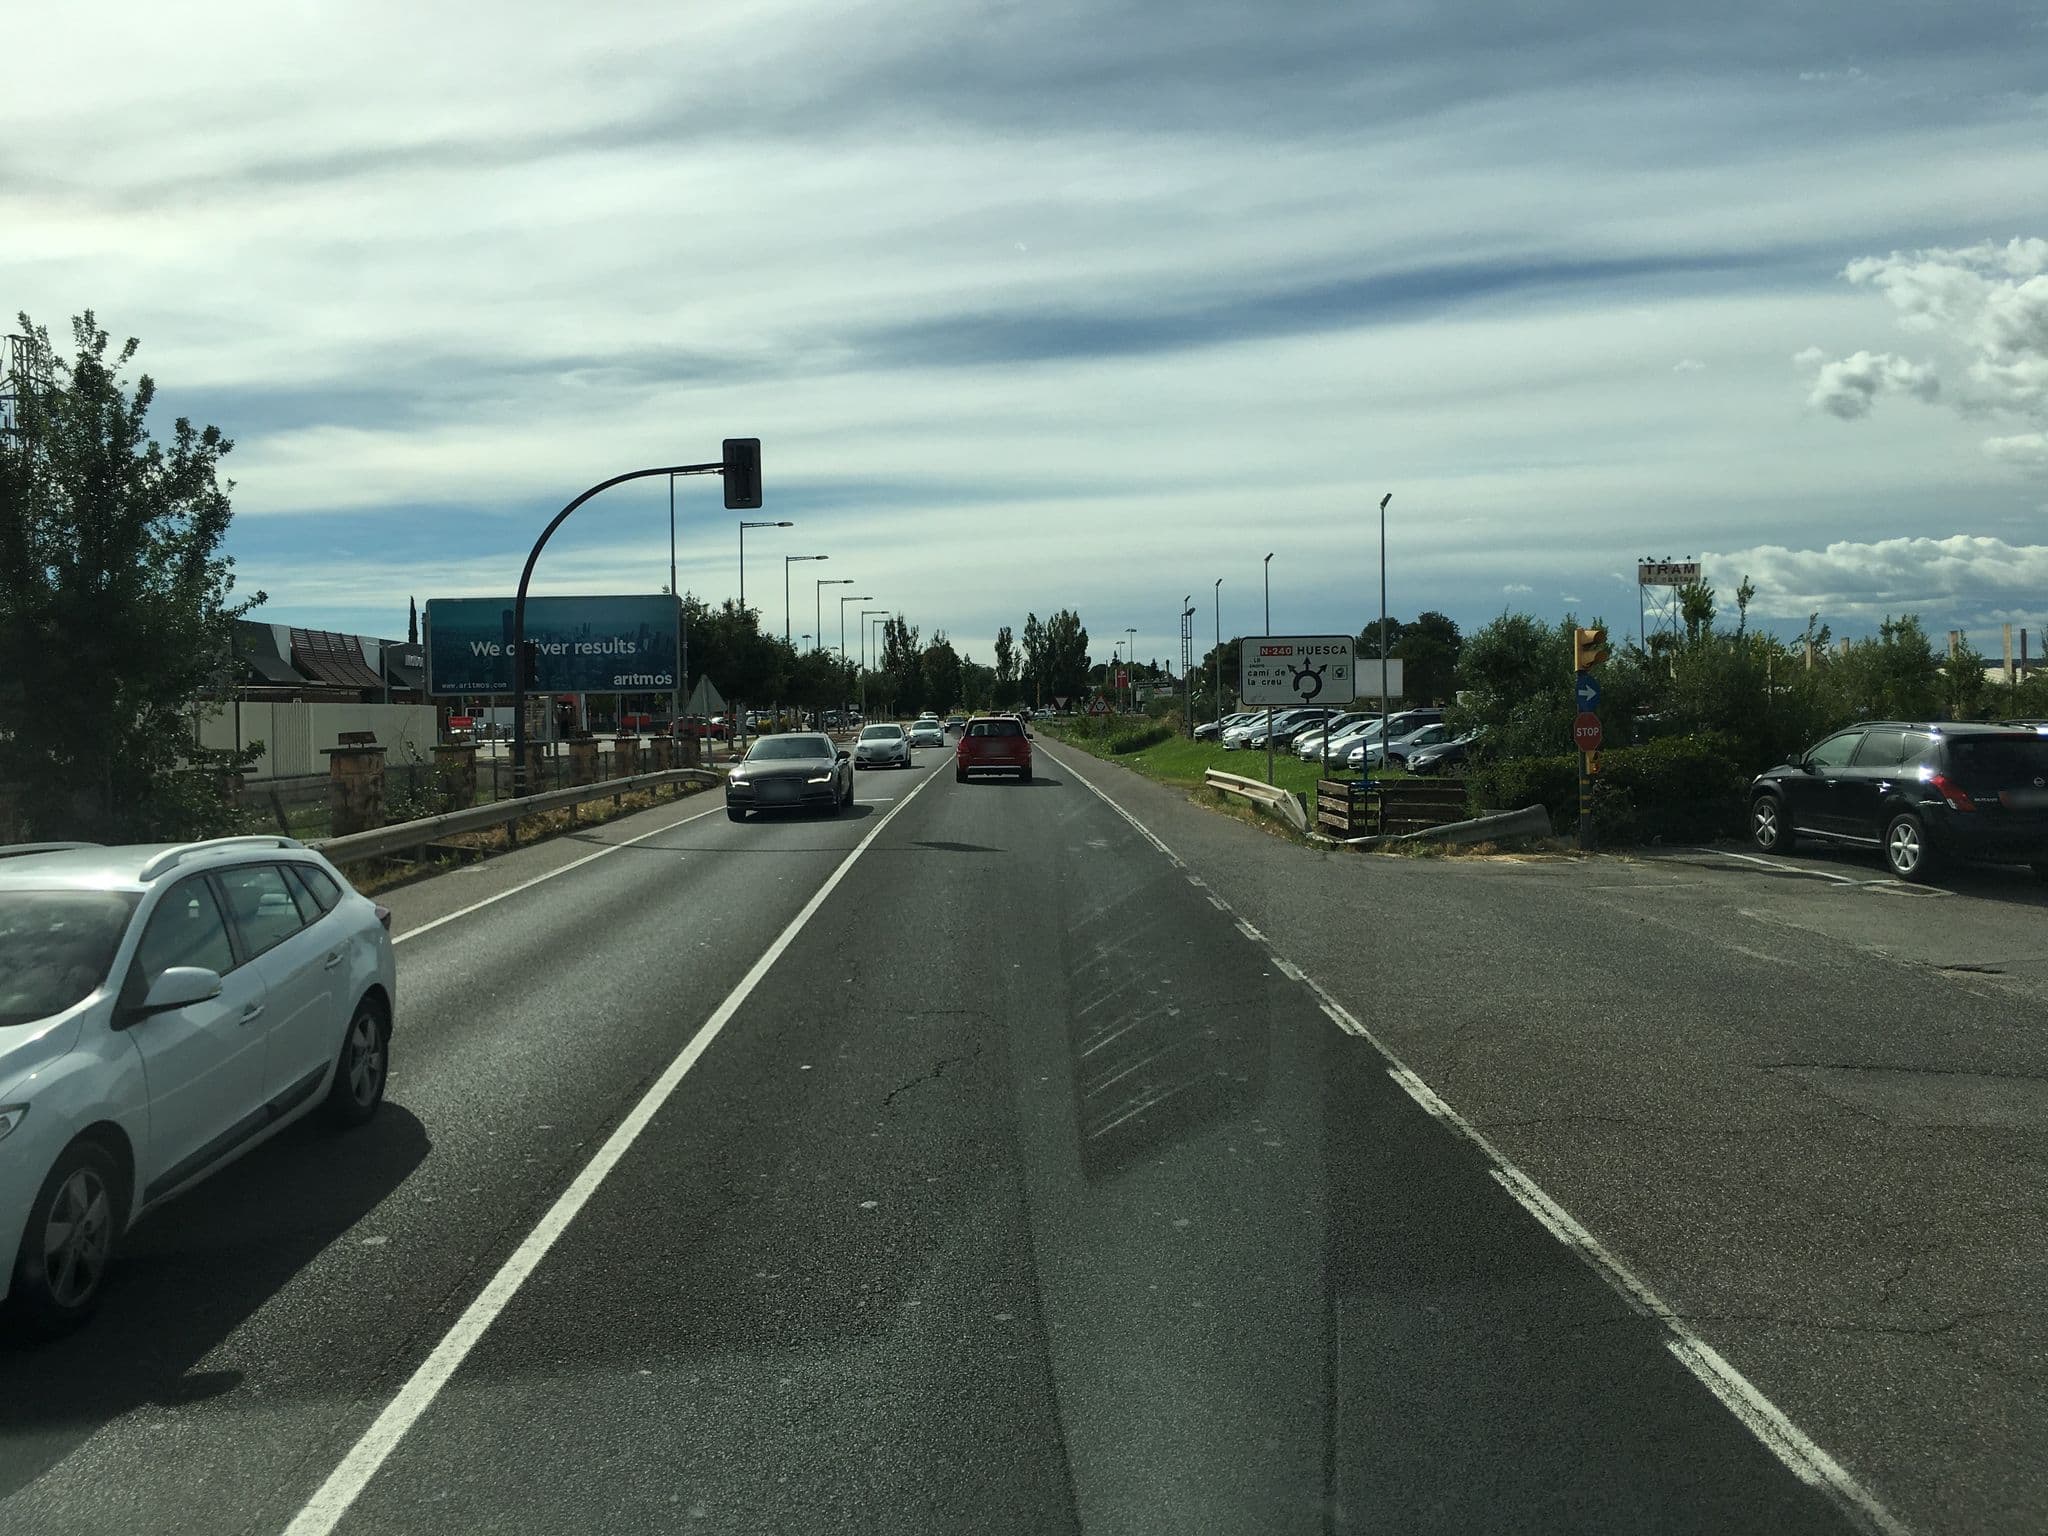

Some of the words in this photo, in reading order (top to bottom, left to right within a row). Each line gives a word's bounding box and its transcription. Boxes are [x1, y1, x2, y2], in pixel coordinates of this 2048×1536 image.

[1644, 564, 1696, 574] TRAM
[471, 641, 500, 656] We
[575, 637, 636, 654] results
[1261, 647, 1292, 655] N-240
[1297, 646, 1347, 655] HUESCA
[613, 672, 673, 685] aritmos
[1247, 678, 1256, 686] la
[1576, 727, 1600, 737] STOP
